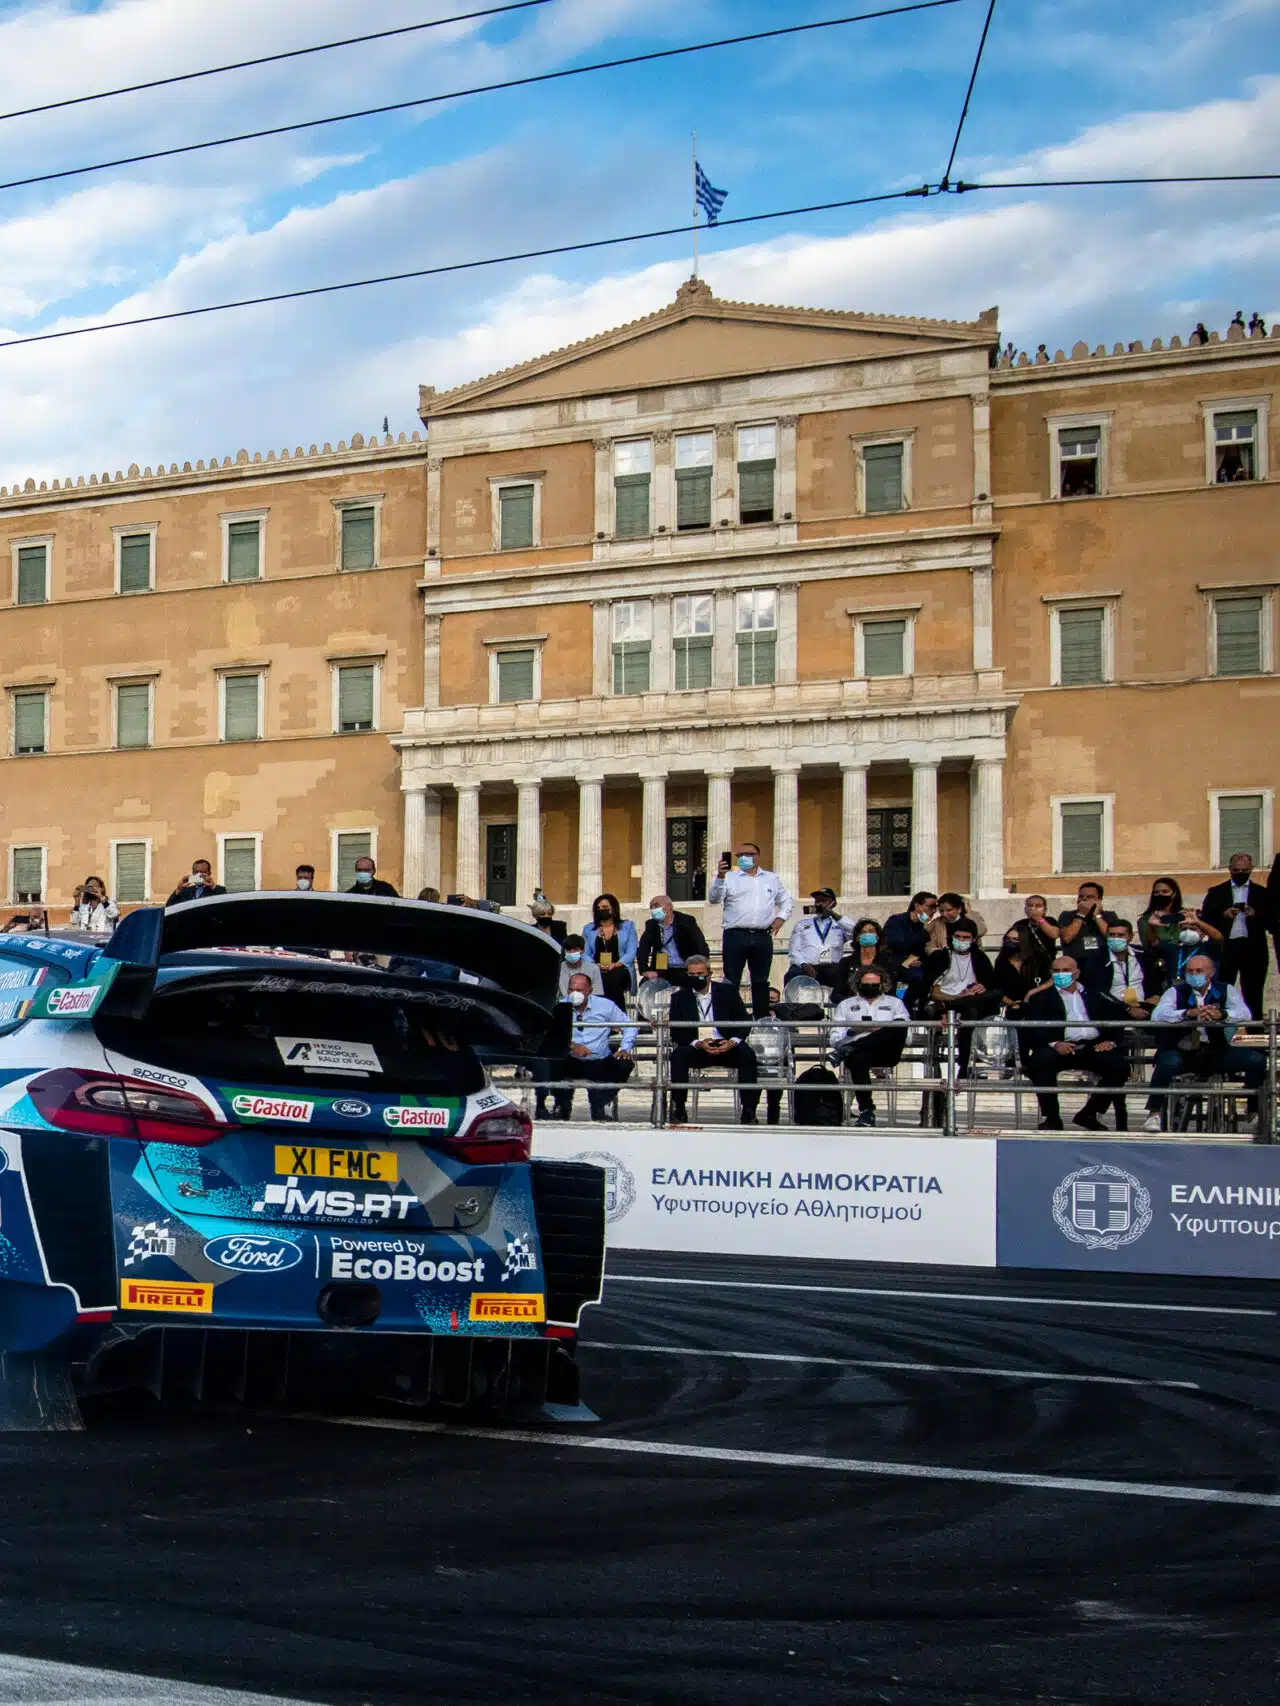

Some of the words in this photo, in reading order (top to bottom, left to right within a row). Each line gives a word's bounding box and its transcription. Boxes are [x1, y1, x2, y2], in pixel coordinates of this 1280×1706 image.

[59, 989, 95, 1012] Castrol
[132, 1067, 188, 1087] sparco
[252, 1098, 308, 1119] Castrol
[401, 1108, 446, 1126] Castrol
[329, 1151, 382, 1180] FMC
[652, 1168, 772, 1189] ΕΛΛΗΝΙΚΗ
[778, 1172, 943, 1194] ΔΗΜΟΚΡΑΤΙΑ
[284, 1189, 418, 1219] MS-RT
[651, 1194, 789, 1218] Υφυπουργείο
[794, 1199, 923, 1223] Αθλητισμού
[220, 1238, 286, 1267] Ford
[330, 1236, 404, 1253] Powered
[405, 1239, 426, 1256] by
[331, 1252, 485, 1282] EcoBoost
[128, 1285, 206, 1307] PIRELLI
[475, 1298, 539, 1317] PIRELLI
